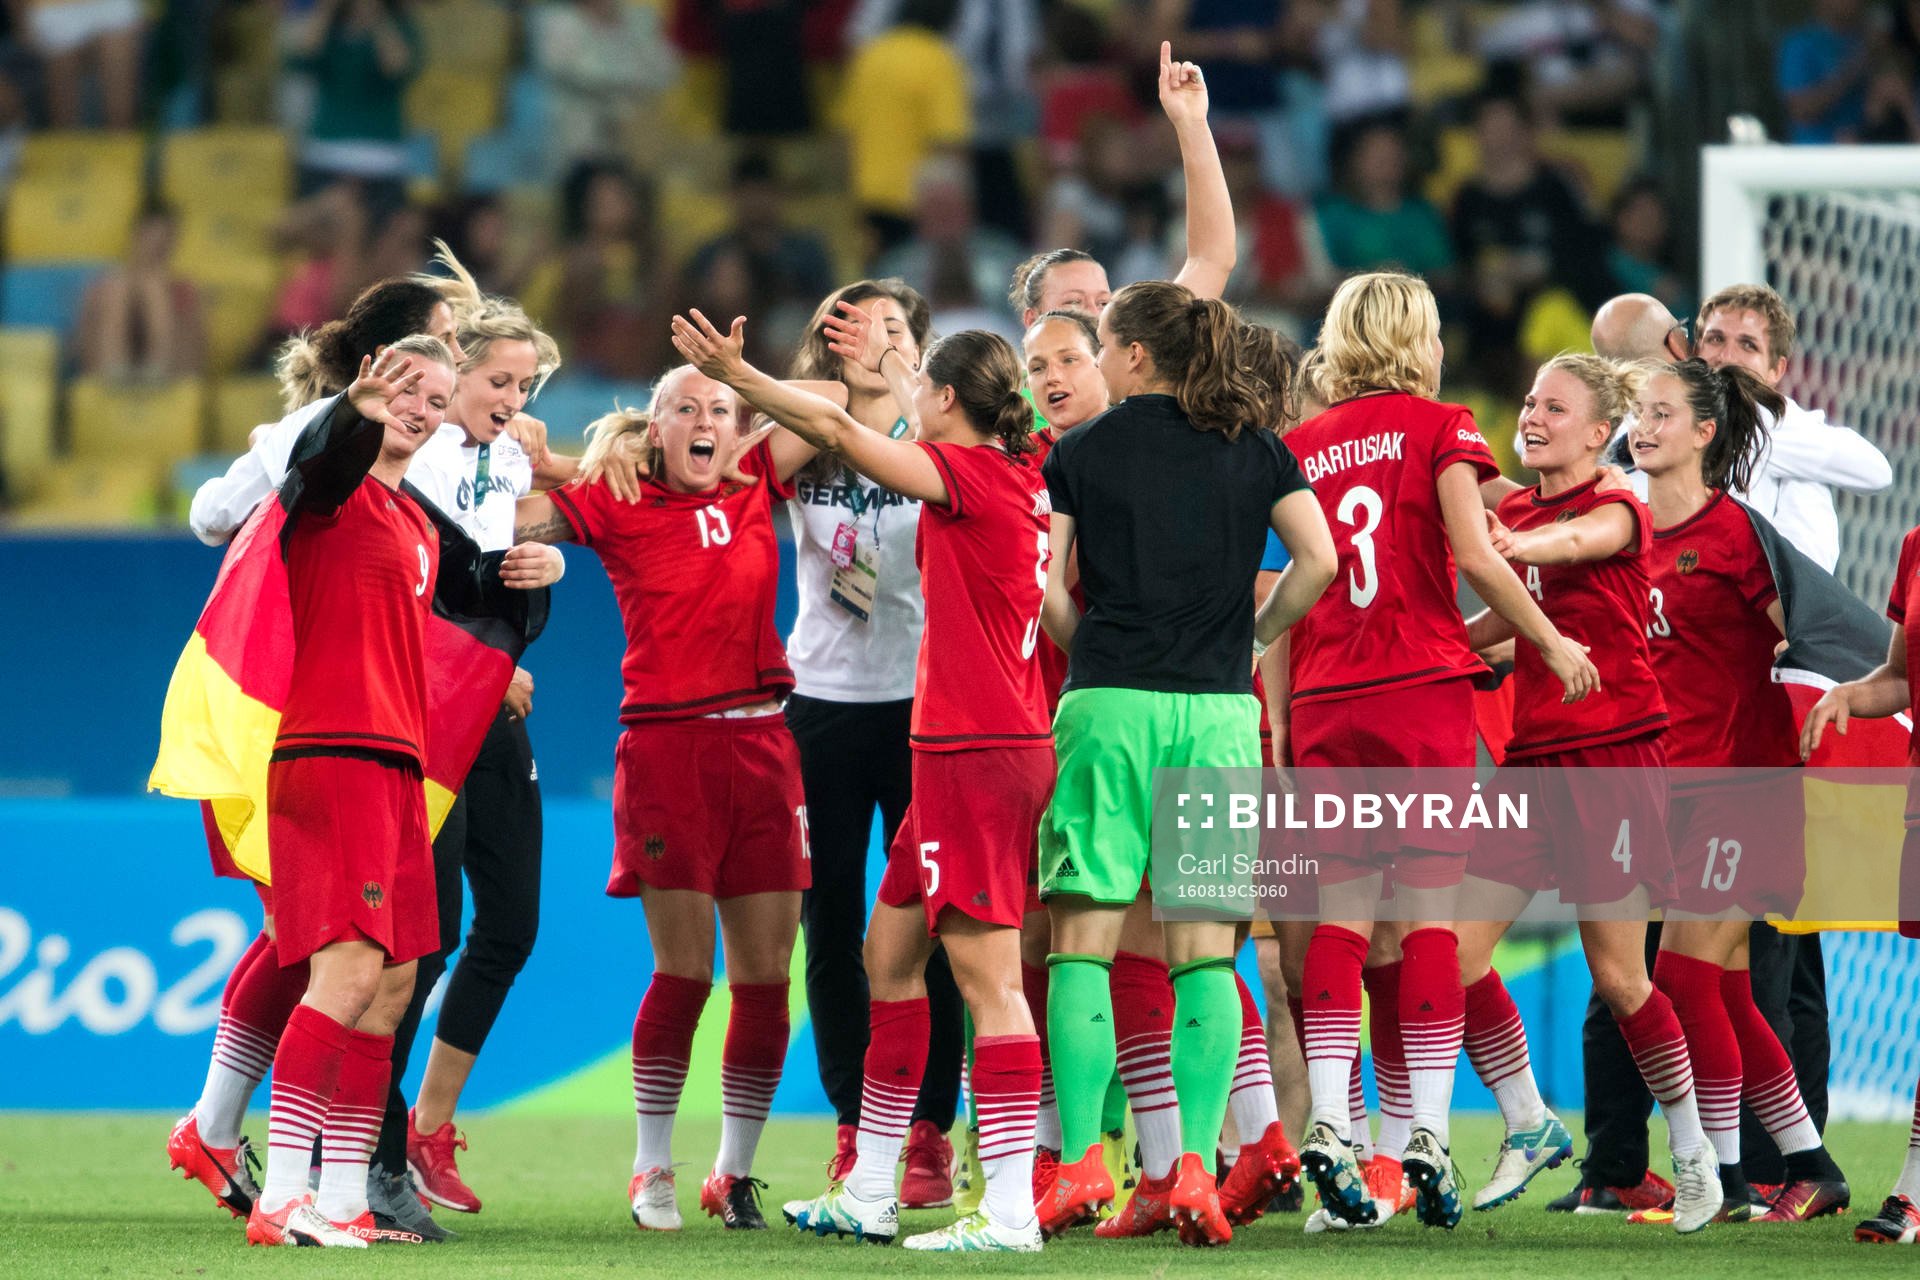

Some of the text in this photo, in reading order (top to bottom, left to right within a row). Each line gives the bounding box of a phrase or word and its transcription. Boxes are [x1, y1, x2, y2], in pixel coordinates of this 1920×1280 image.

[1304, 431, 1405, 483] BARTUSIAK
[415, 544, 429, 597] 9
[1337, 485, 1383, 609] 3
[1526, 564, 1544, 600] 4
[919, 841, 941, 897] 5
[1611, 819, 1632, 873] 4
[1701, 837, 1742, 892] 13
